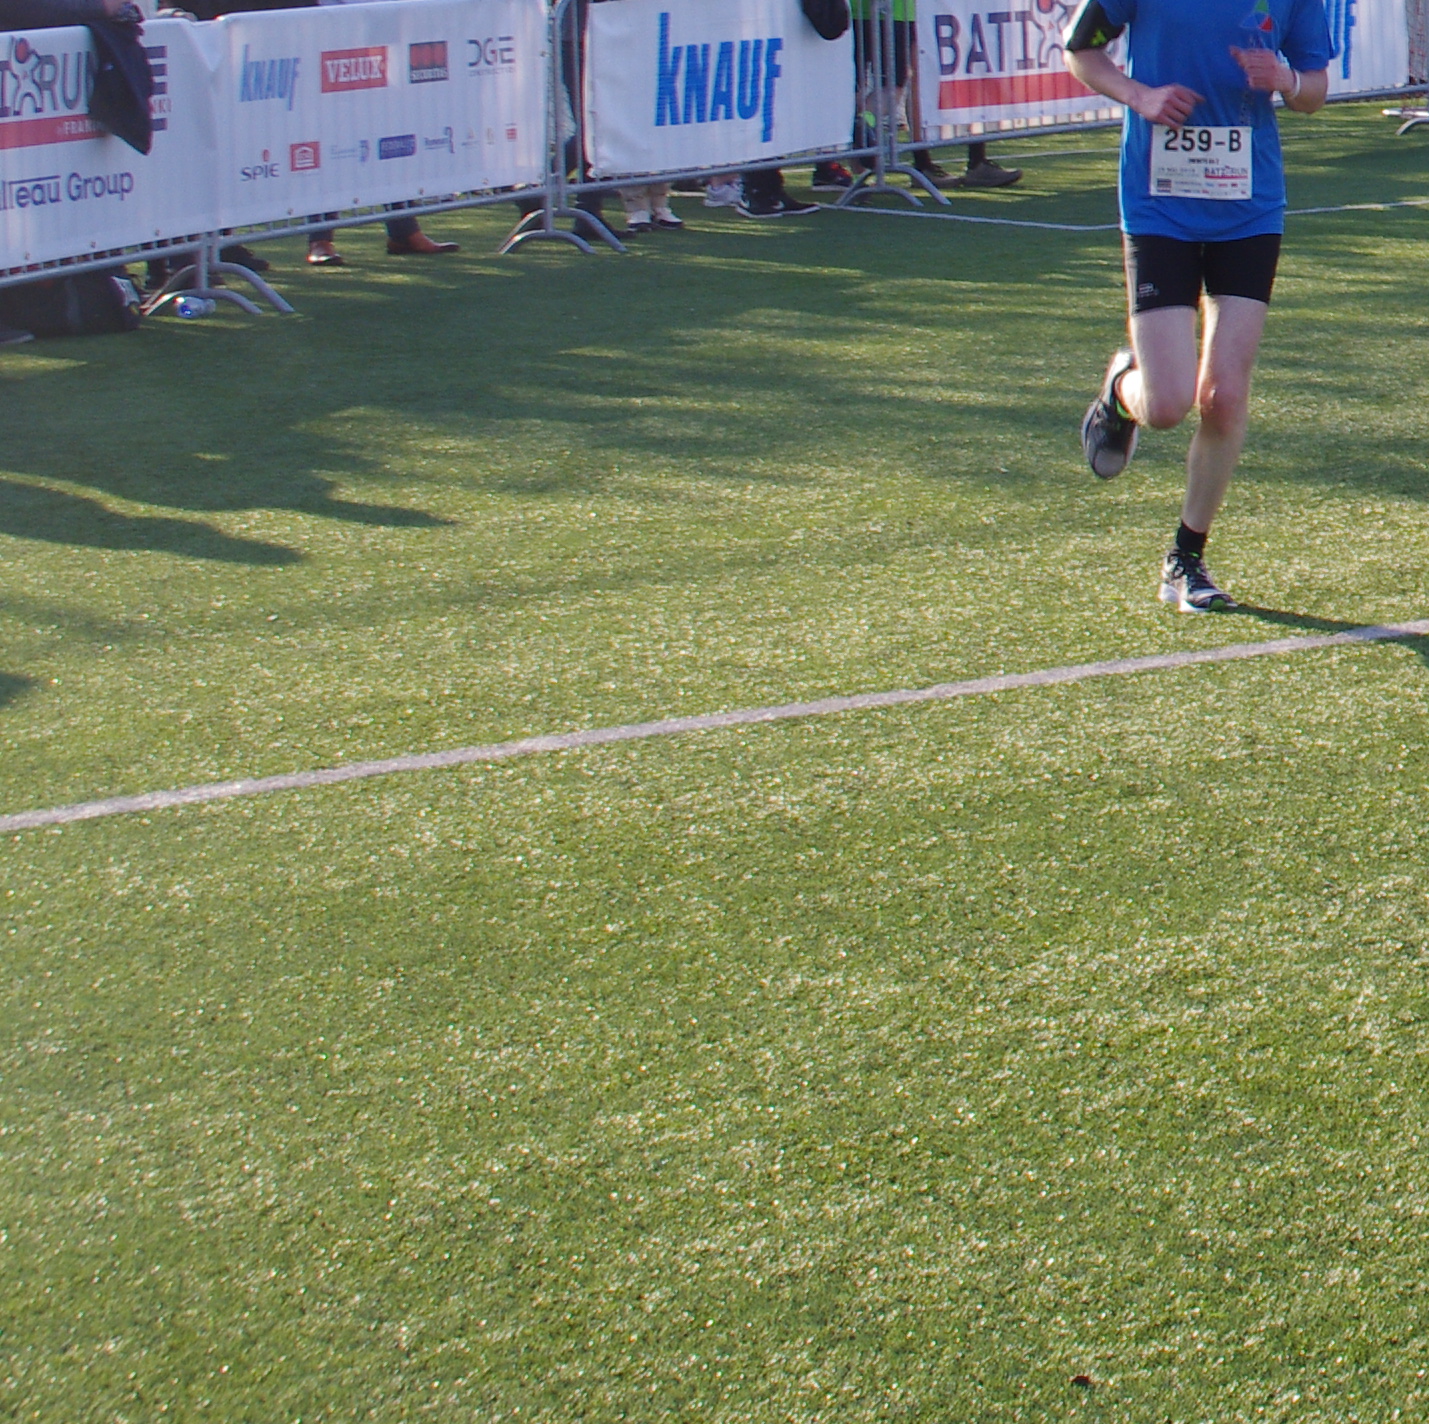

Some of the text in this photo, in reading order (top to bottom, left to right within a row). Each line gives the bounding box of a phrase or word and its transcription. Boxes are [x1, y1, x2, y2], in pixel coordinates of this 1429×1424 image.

[935, 9, 1035, 75] BATI
[324, 55, 384, 84] VELUX
[654, 12, 783, 143] KNAUF
[1165, 129, 1242, 152] 259-B
[67, 172, 134, 201] Group
[240, 162, 281, 182] SPIE
